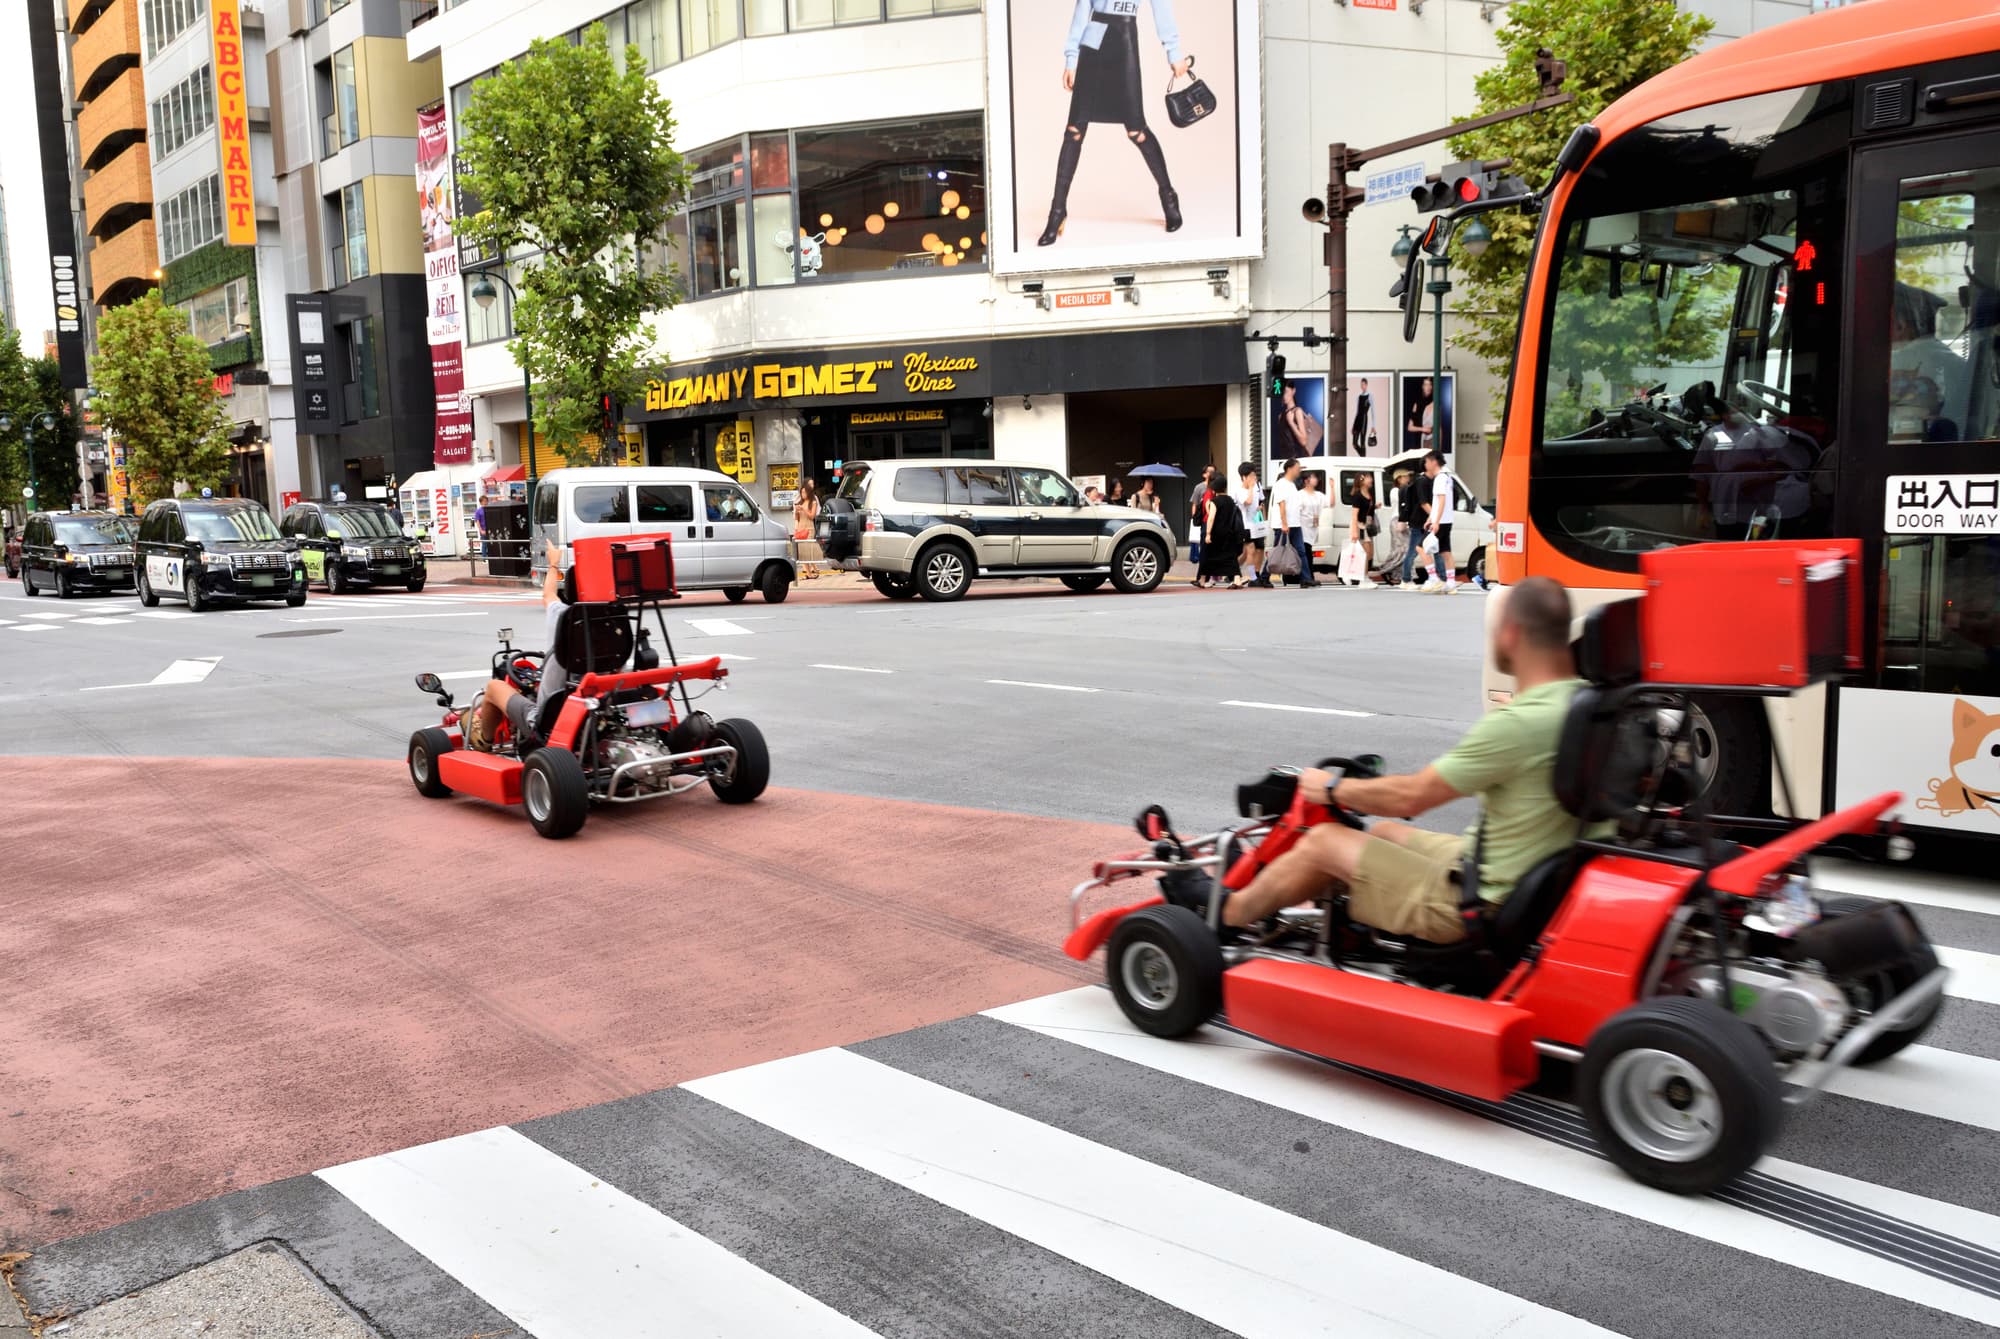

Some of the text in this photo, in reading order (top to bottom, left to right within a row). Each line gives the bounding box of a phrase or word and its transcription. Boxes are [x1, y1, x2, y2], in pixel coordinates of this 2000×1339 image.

[217, 12, 250, 227] ABC-MART
[53, 255, 79, 332] DOUTOR
[1060, 295, 1085, 305] MEDIA
[903, 352, 978, 373] Mexican
[645, 371, 730, 412] GUZMAN
[732, 367, 748, 399] Y
[905, 372, 956, 392] Diner
[851, 409, 944, 424] GUZMAN Y GOMEZ
[739, 432, 753, 474] GYG!
[1897, 480, 1999, 510] 出入口
[435, 489, 449, 535] KIRIN
[1896, 514, 1999, 528] DOOR WAY
